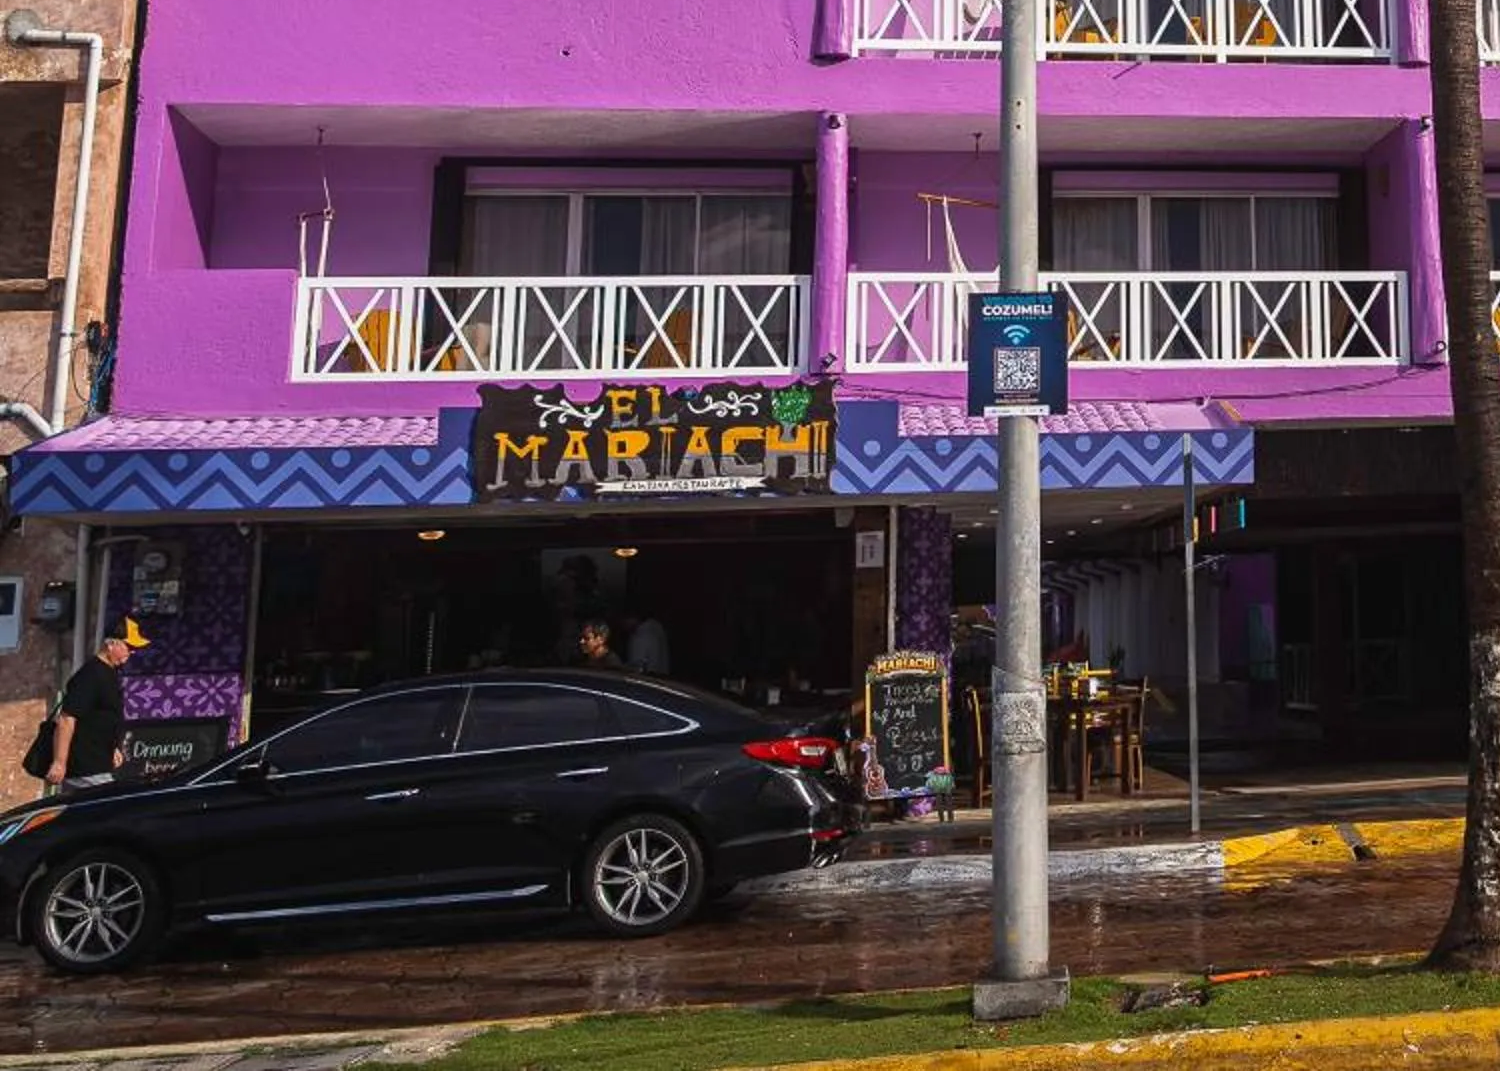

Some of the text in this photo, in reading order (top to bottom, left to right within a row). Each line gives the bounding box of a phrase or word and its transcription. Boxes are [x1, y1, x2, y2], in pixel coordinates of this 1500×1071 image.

[605, 387, 678, 428] EL
[485, 420, 829, 490] MARIACHI
[877, 656, 937, 673] MARIACHI
